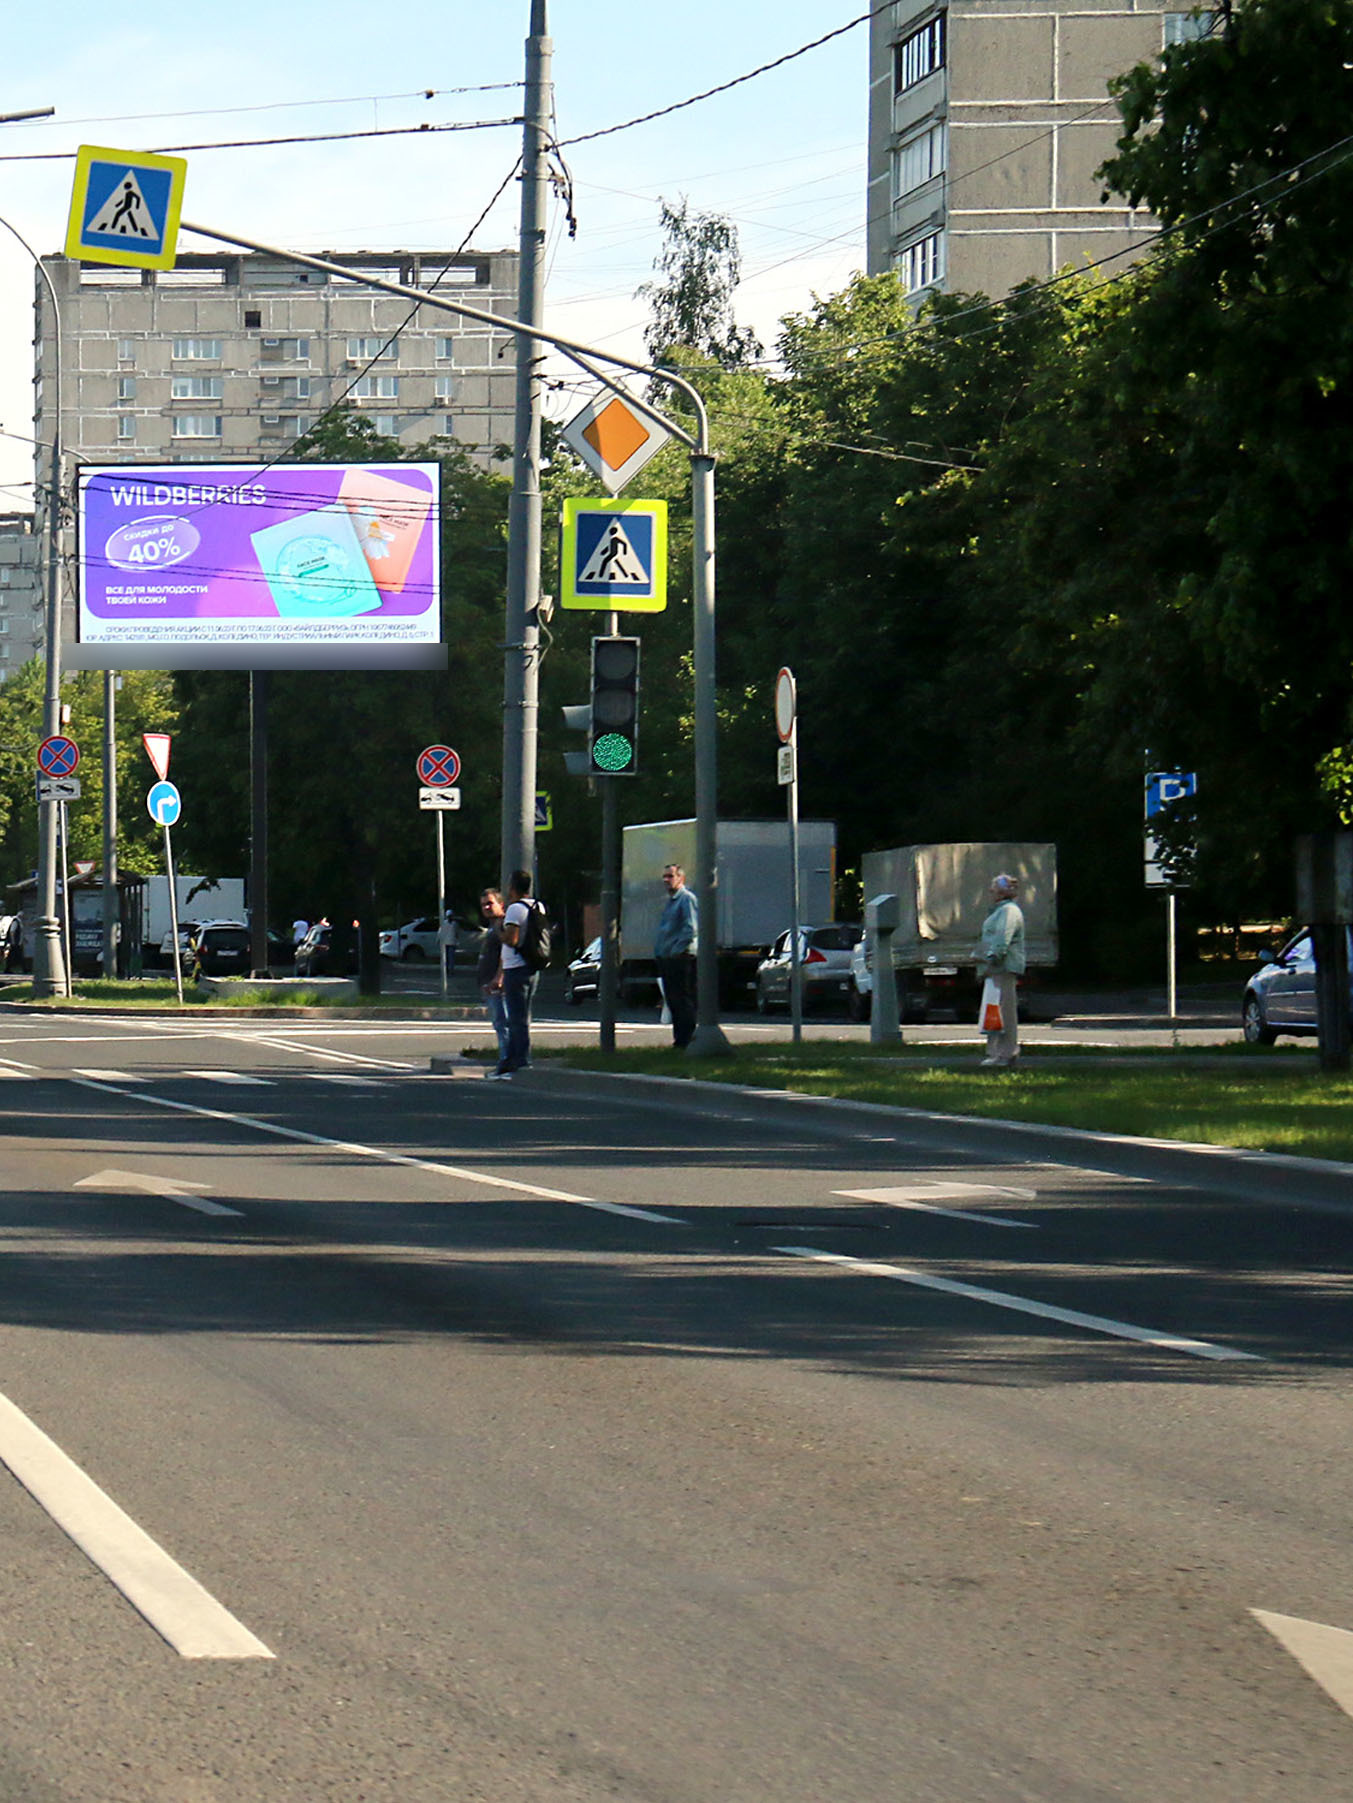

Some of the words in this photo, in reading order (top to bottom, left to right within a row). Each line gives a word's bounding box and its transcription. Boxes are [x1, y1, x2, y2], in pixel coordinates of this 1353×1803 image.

[127, 536, 181, 563] 40%
[105, 586, 124, 594] ВСЕ
[125, 585, 145, 595] ДЛЯ
[147, 585, 208, 595] МОЛОДОСТИ
[105, 595, 137, 604] ТВОЕЙ
[138, 595, 167, 604] КОЖИ
